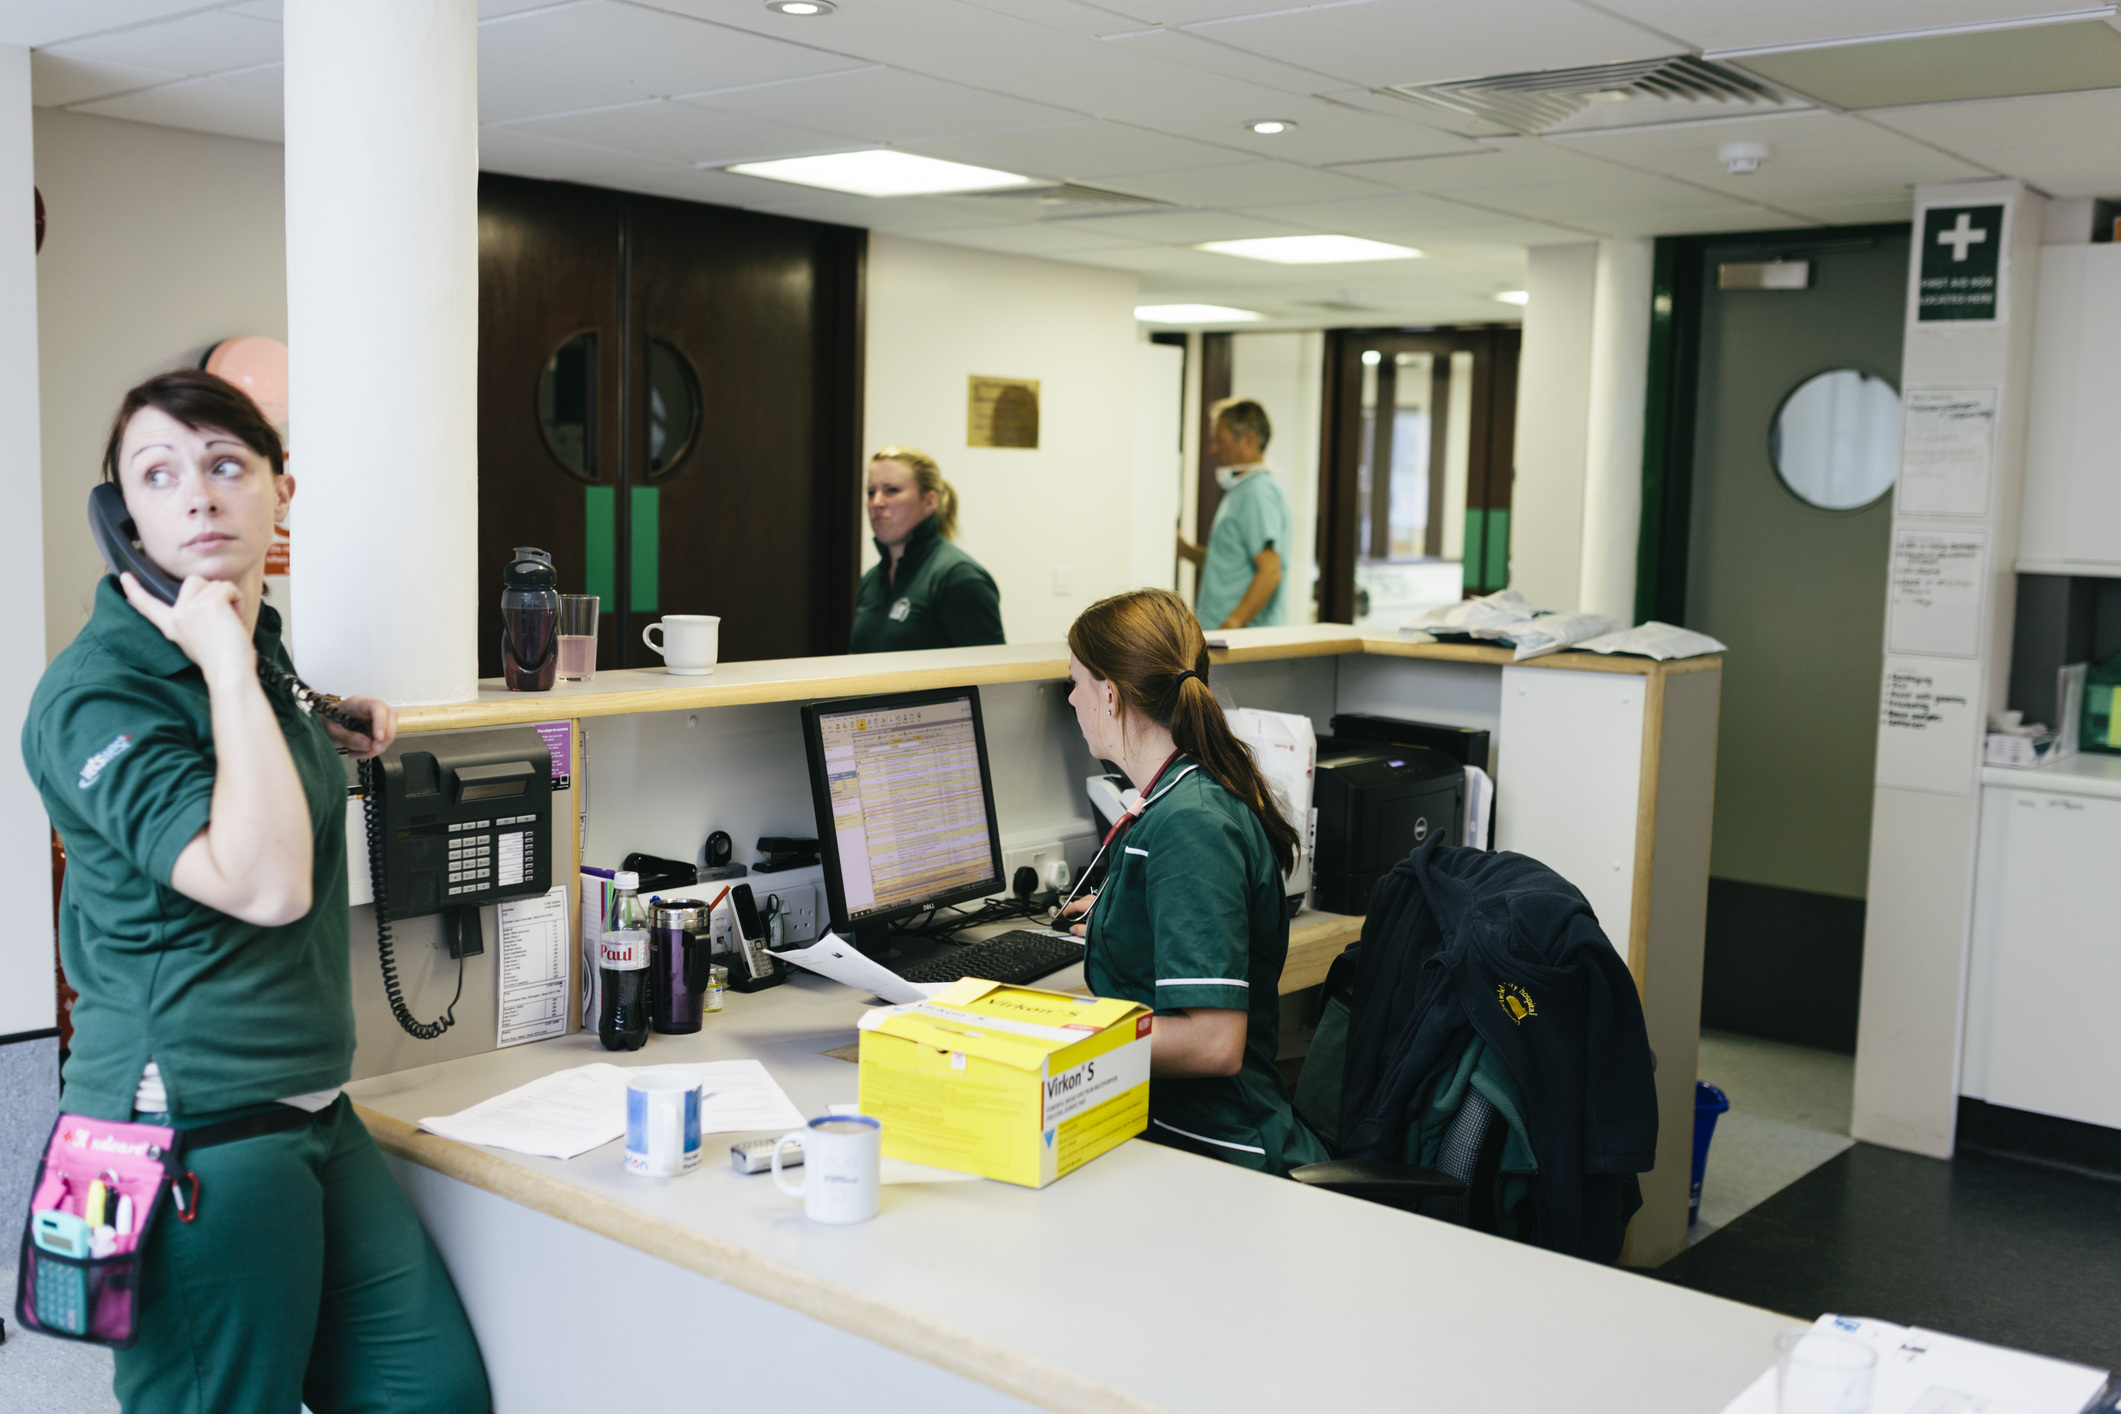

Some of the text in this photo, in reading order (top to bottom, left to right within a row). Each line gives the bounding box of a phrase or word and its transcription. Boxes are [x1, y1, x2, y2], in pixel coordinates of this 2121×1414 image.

[1921, 276, 1994, 289] FIRST AID BOX
[1920, 294, 1994, 306] LOCATED HERE
[922, 902, 935, 911] DELL
[601, 944, 632, 961] Paul
[1519, 987, 1538, 1016] hospital
[1087, 1061, 1095, 1082] S
